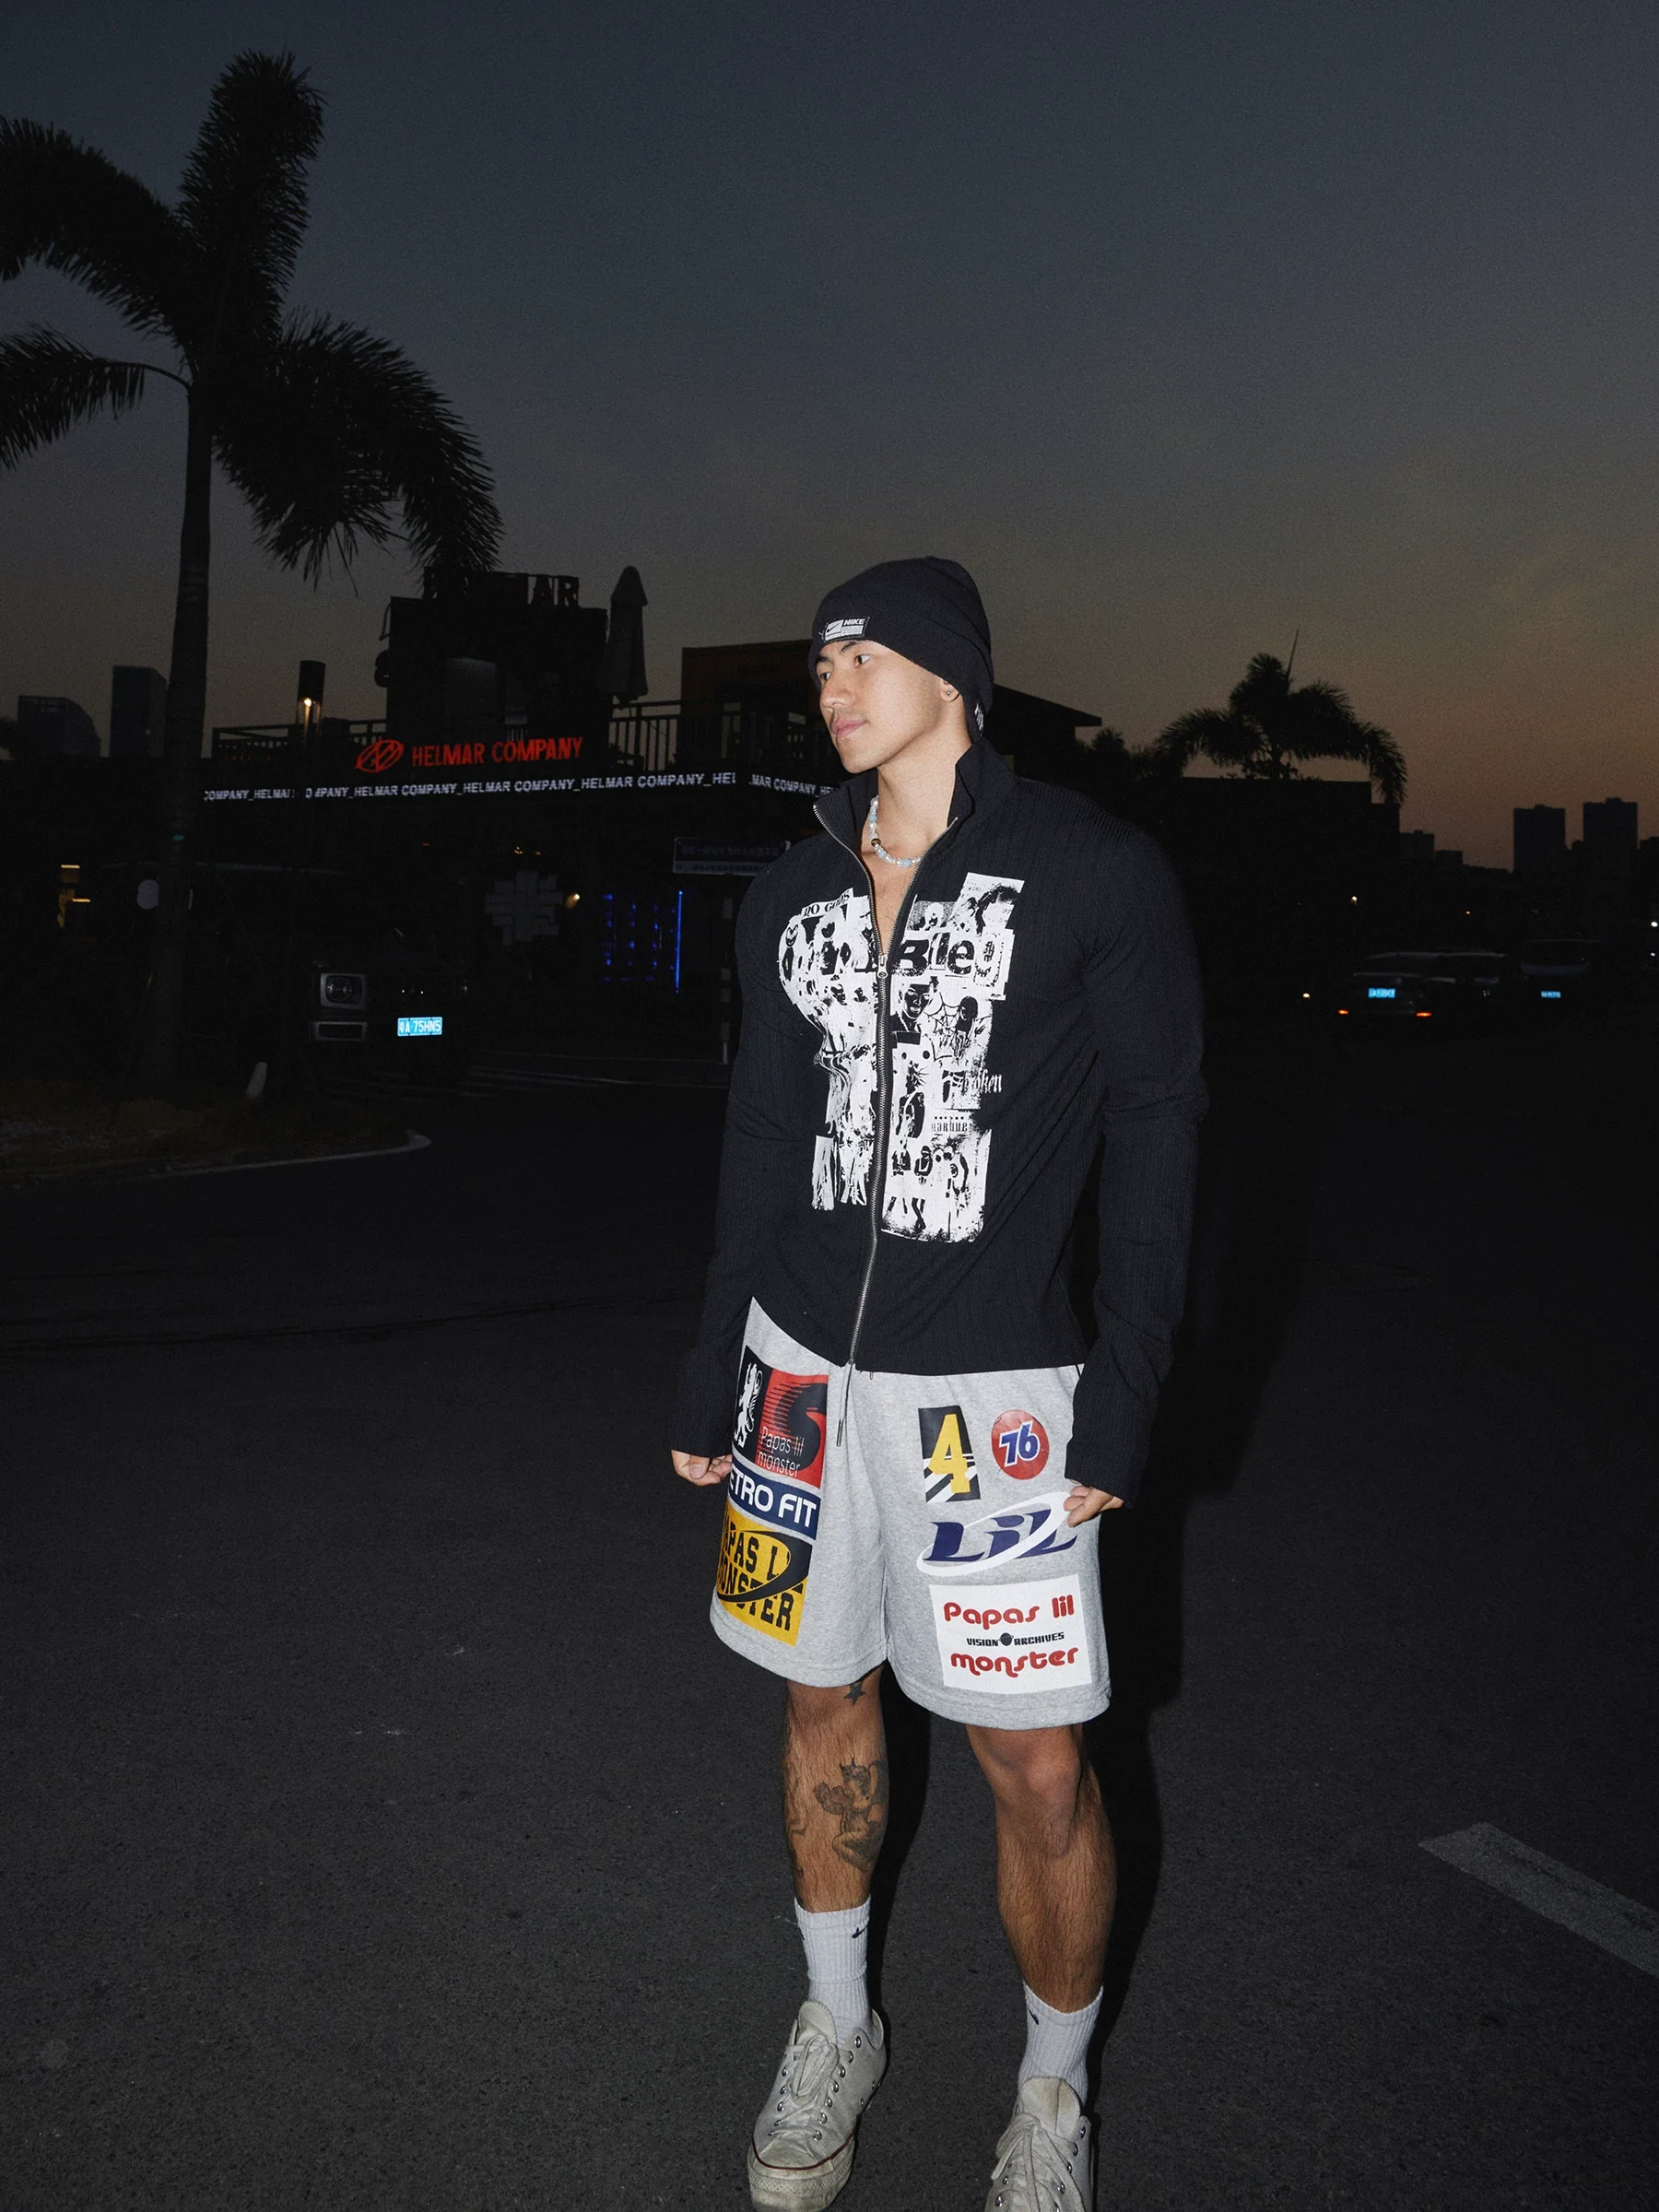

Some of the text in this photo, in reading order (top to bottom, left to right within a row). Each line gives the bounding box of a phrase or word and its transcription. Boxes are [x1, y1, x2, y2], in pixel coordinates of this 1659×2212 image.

[412, 737, 582, 767] HELMAR COMPANY
[760, 1426, 792, 1454] Papas
[998, 1421, 1041, 1468] 76
[757, 1451, 801, 1477] monster
[778, 1493, 817, 1528] FIT
[943, 1594, 1075, 1630] Papas lil
[966, 1631, 1065, 1647] VISION ARCHIVES
[950, 1647, 1079, 1678] monster
